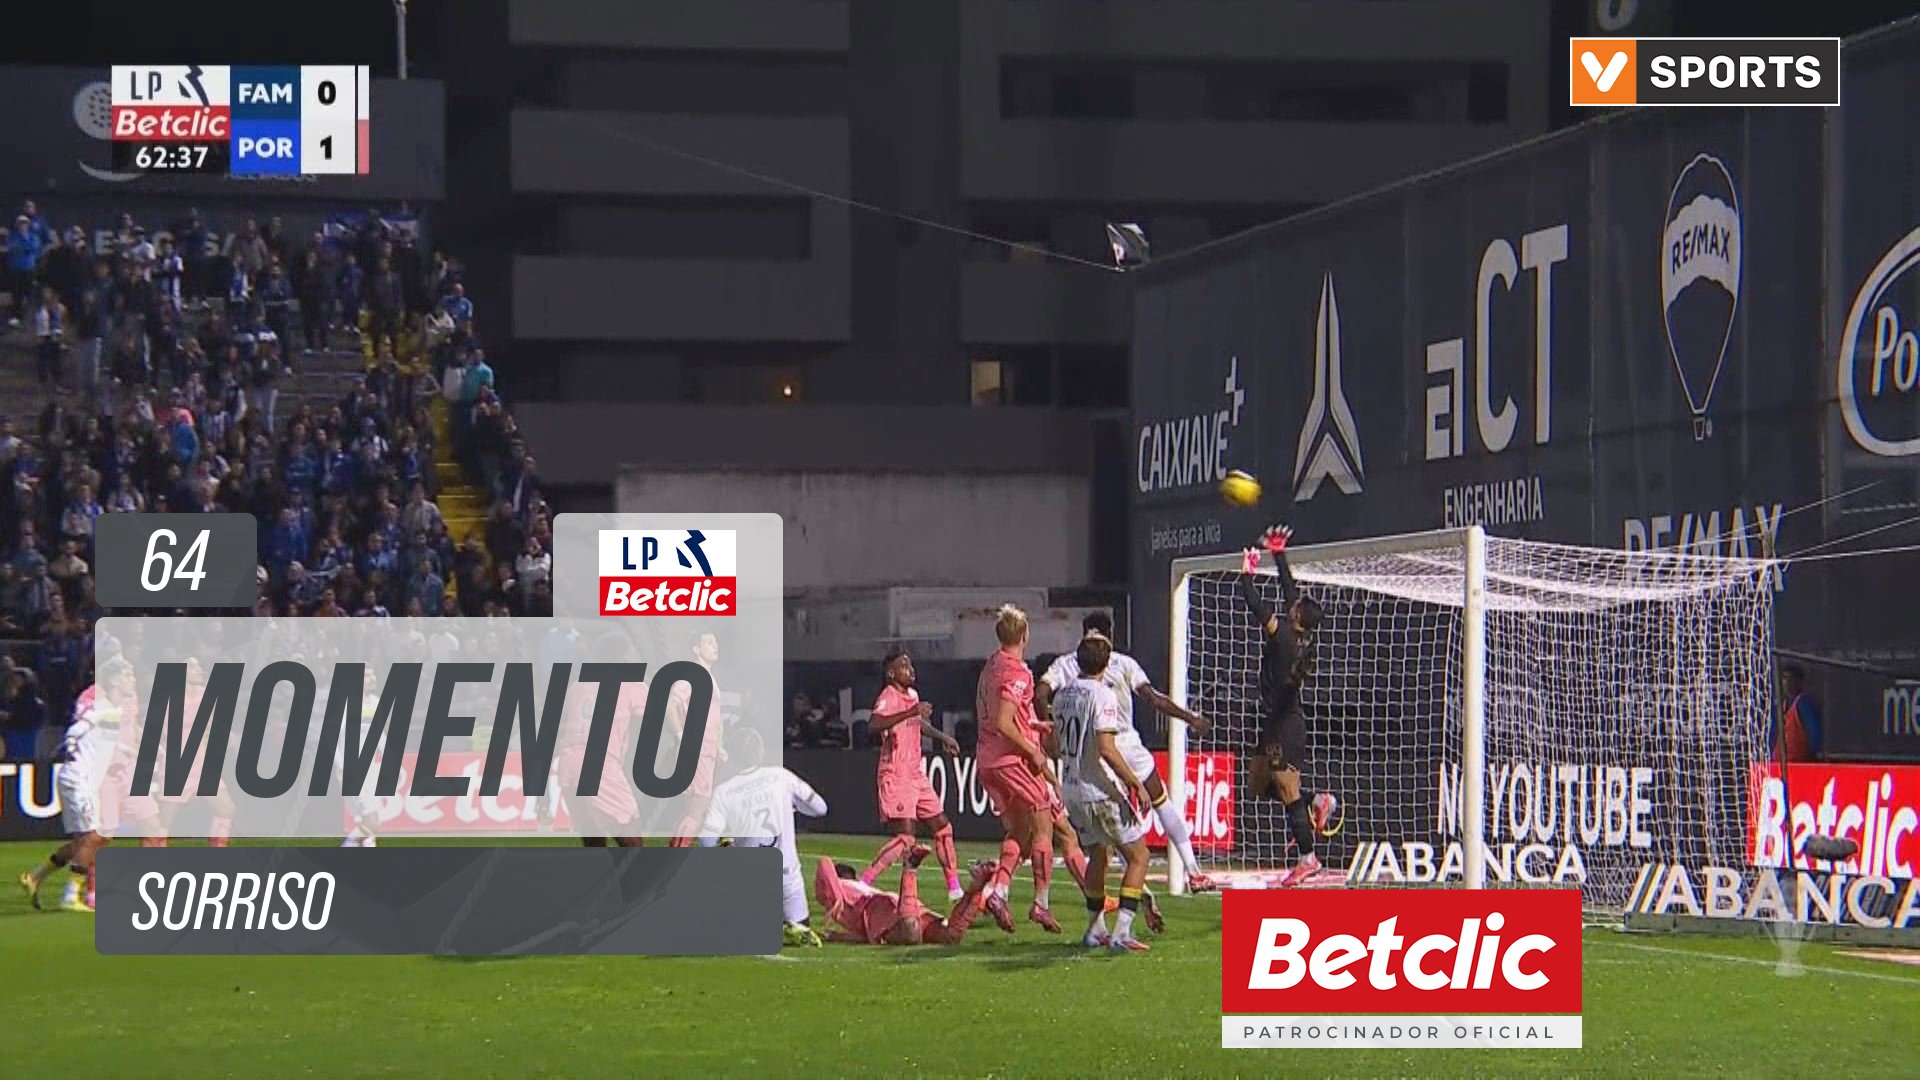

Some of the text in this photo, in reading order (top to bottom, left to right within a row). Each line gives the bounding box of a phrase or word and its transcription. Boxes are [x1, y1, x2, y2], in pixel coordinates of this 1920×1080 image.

[1671, 223, 1731, 275] RE/MAX
[1137, 409, 1230, 493] CAIXIAVE
[1443, 476, 1543, 529] ENGENHARIA
[1624, 503, 1784, 594] RE/MAX
[1488, 763, 1653, 848] YOUTUBE
[1753, 773, 1919, 879] Betclic
